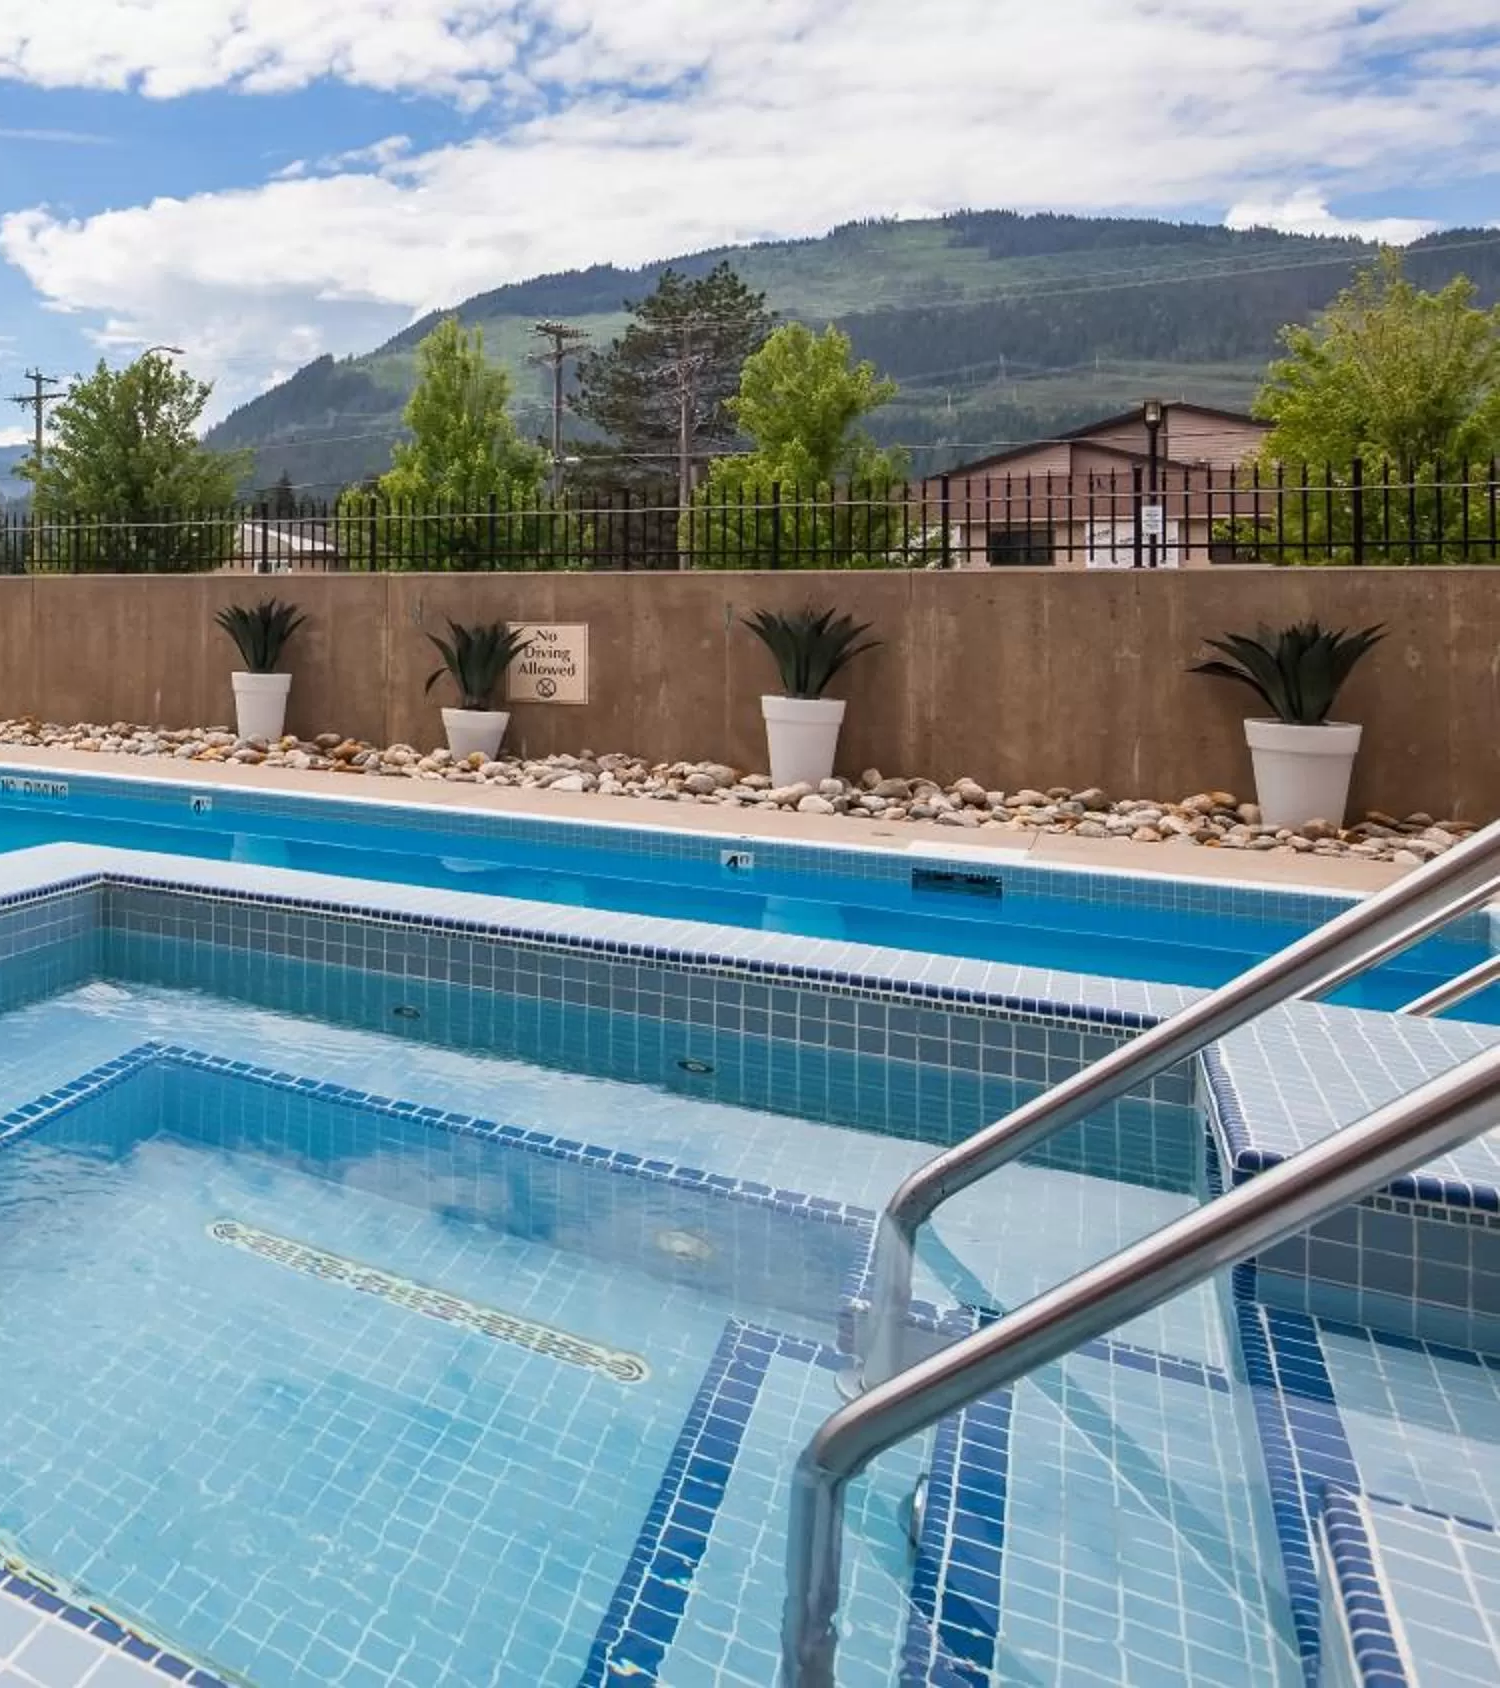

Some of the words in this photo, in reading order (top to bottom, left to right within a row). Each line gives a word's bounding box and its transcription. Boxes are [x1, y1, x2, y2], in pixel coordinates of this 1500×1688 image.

[535, 629, 557, 642] No
[524, 645, 571, 662] Diving
[517, 662, 576, 677] Allowed
